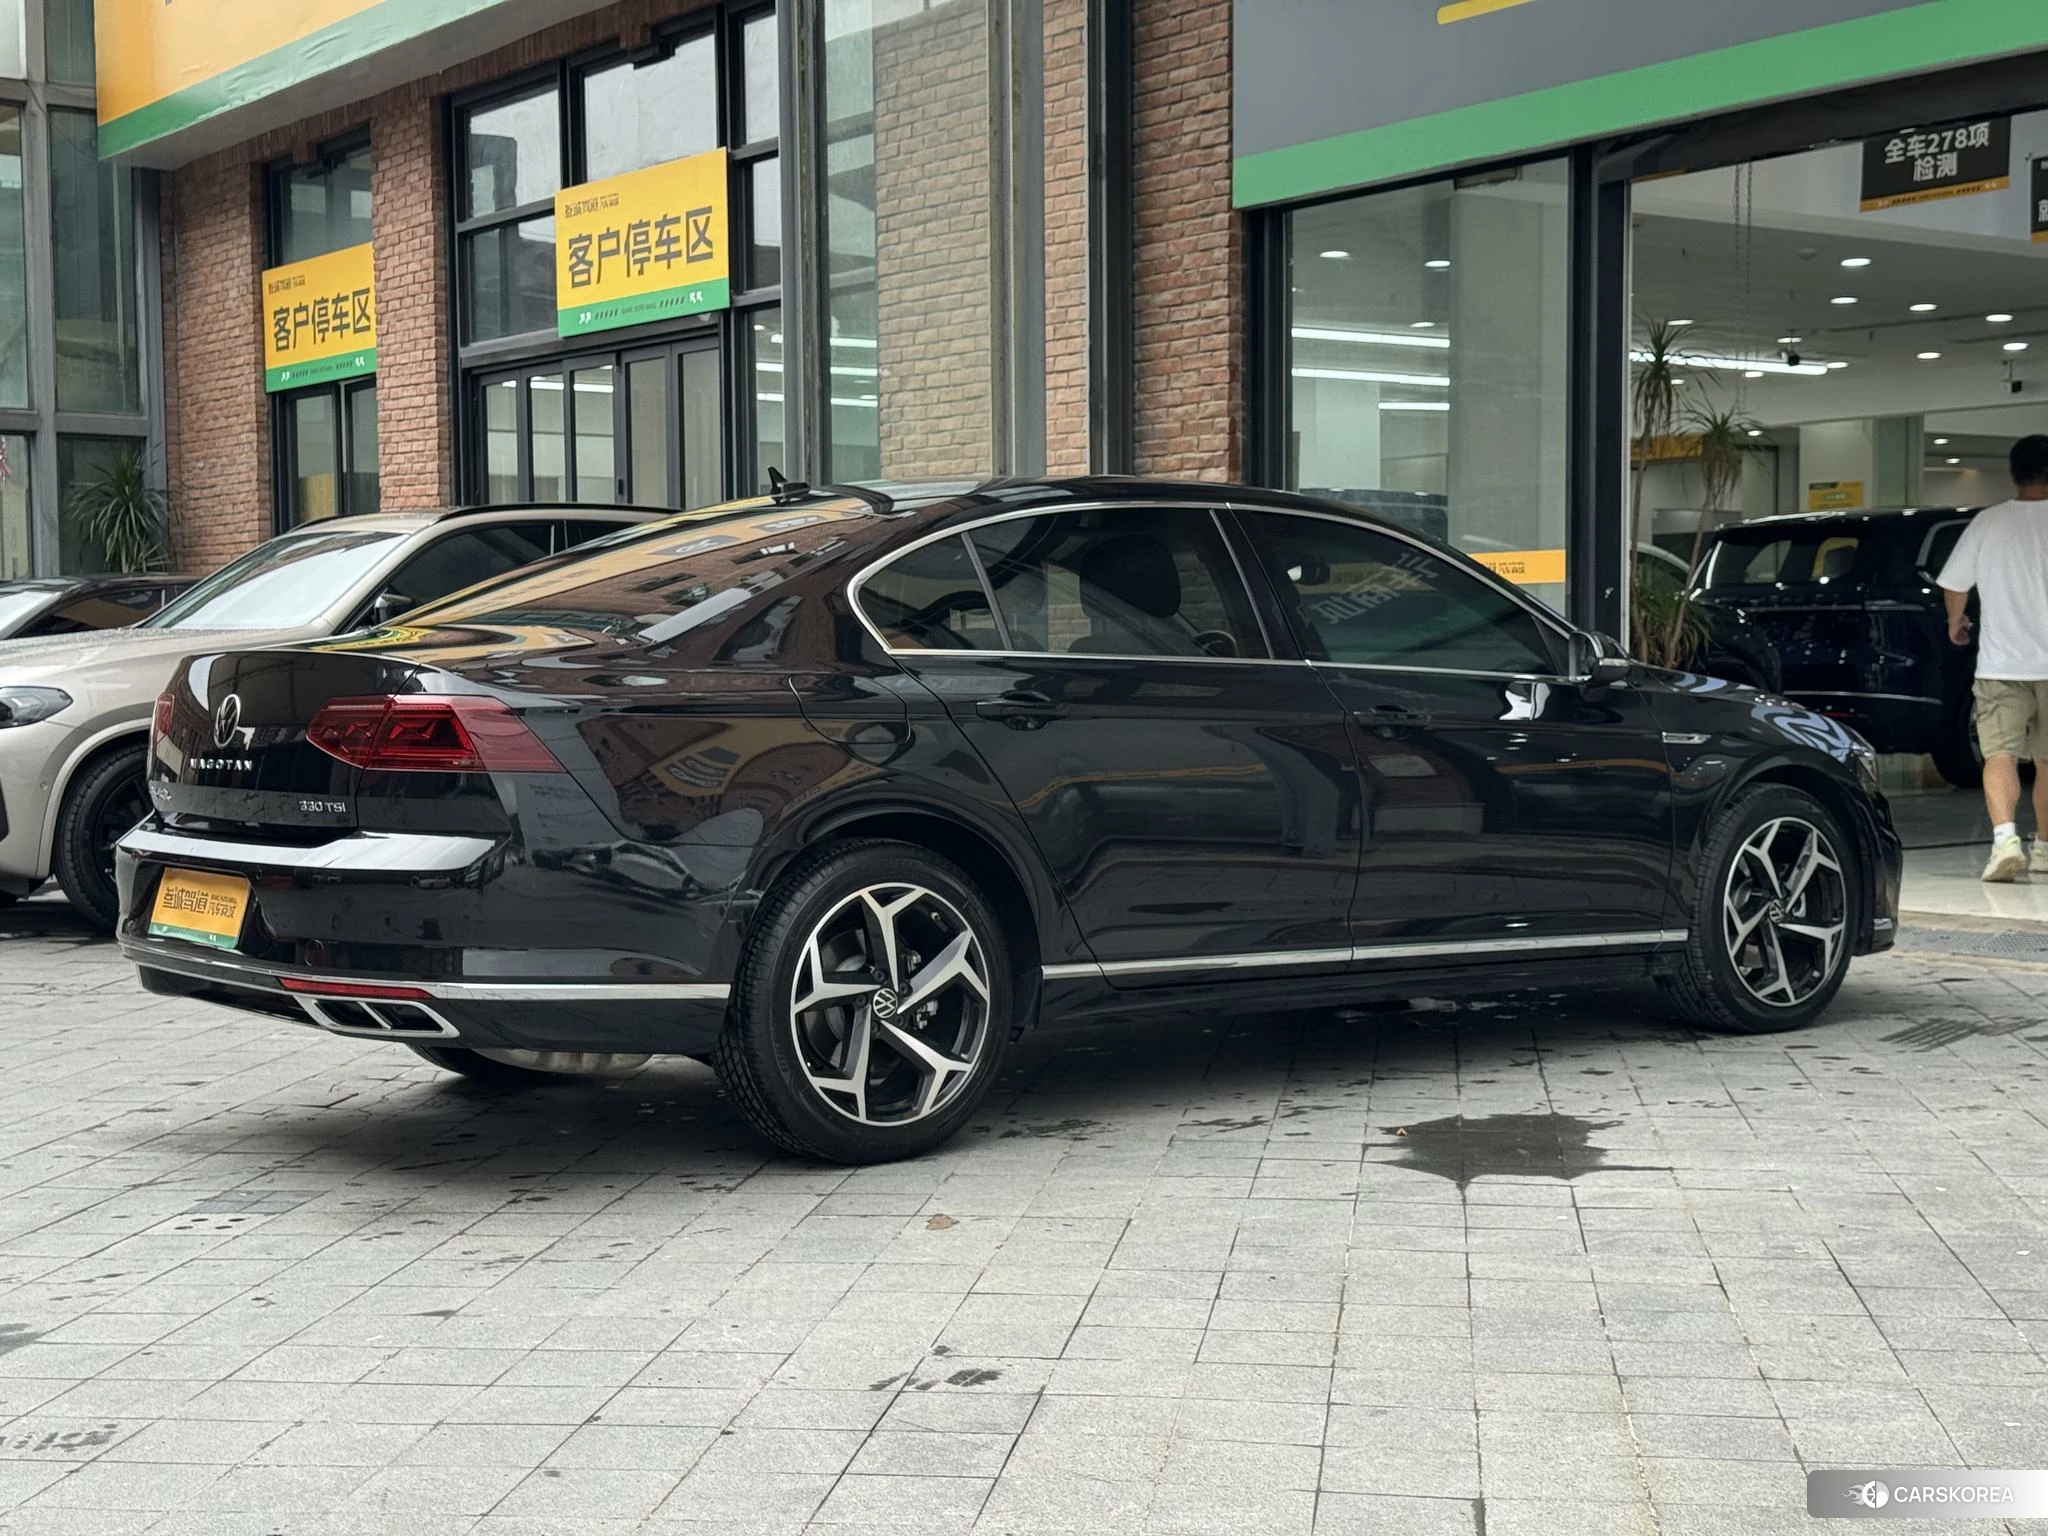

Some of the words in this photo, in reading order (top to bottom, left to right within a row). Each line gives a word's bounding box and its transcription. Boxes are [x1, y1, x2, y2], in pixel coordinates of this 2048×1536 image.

[1885, 122, 1990, 164] 全车278项
[1913, 152, 1958, 182] 检测
[568, 206, 714, 289] 客户停车区
[273, 287, 371, 353] 客户停车区
[299, 800, 323, 812] 330
[324, 802, 346, 813] TSI
